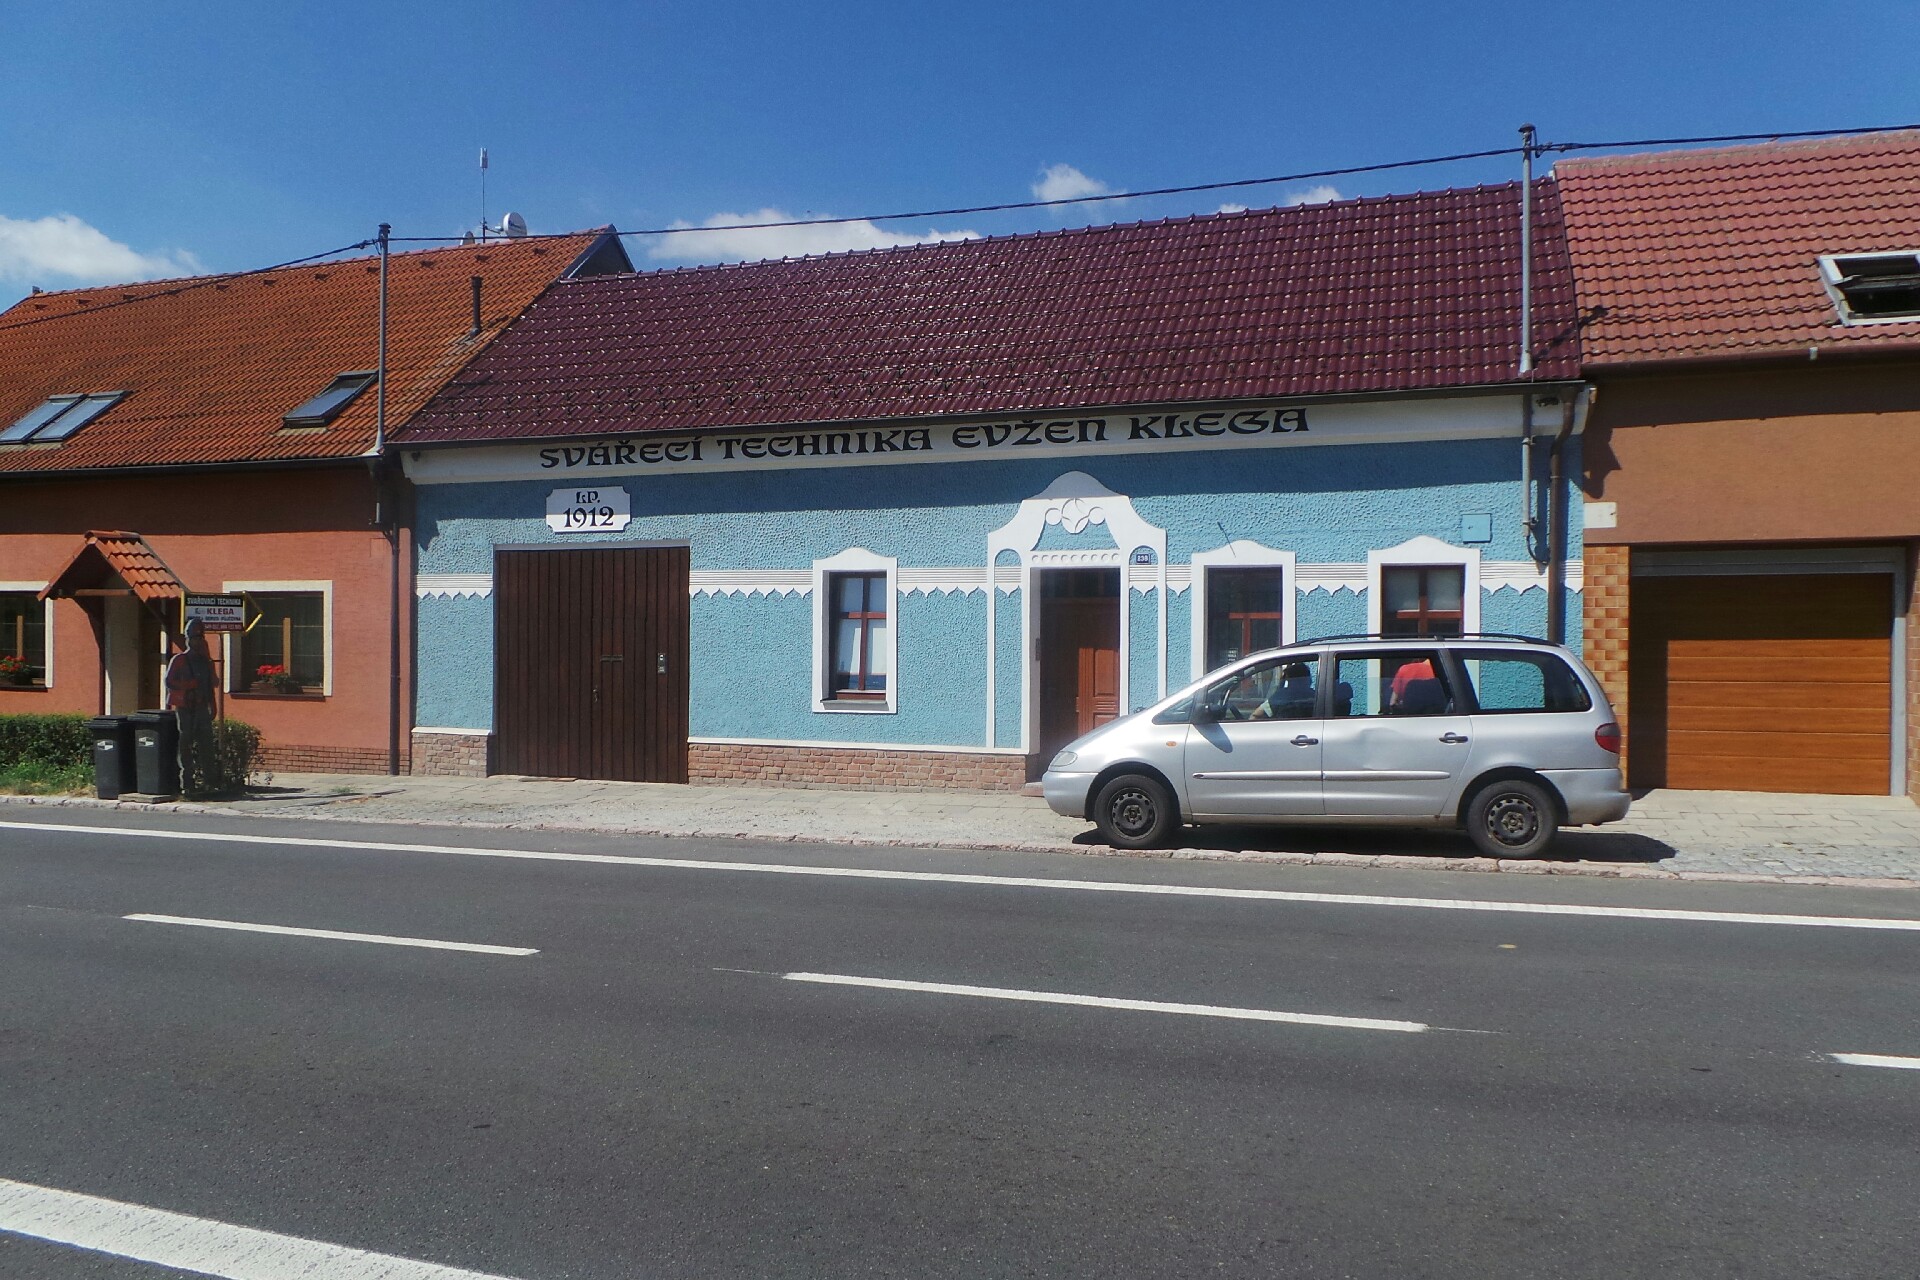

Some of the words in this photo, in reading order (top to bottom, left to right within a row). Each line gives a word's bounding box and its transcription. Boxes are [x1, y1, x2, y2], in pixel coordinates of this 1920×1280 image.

[540, 435, 703, 469] SVÁŘECÍ
[717, 428, 933, 460] TECHNIKA
[952, 419, 1109, 449] EVŽEN
[1127, 408, 1310, 441] KLEGA
[562, 506, 615, 528] 1912
